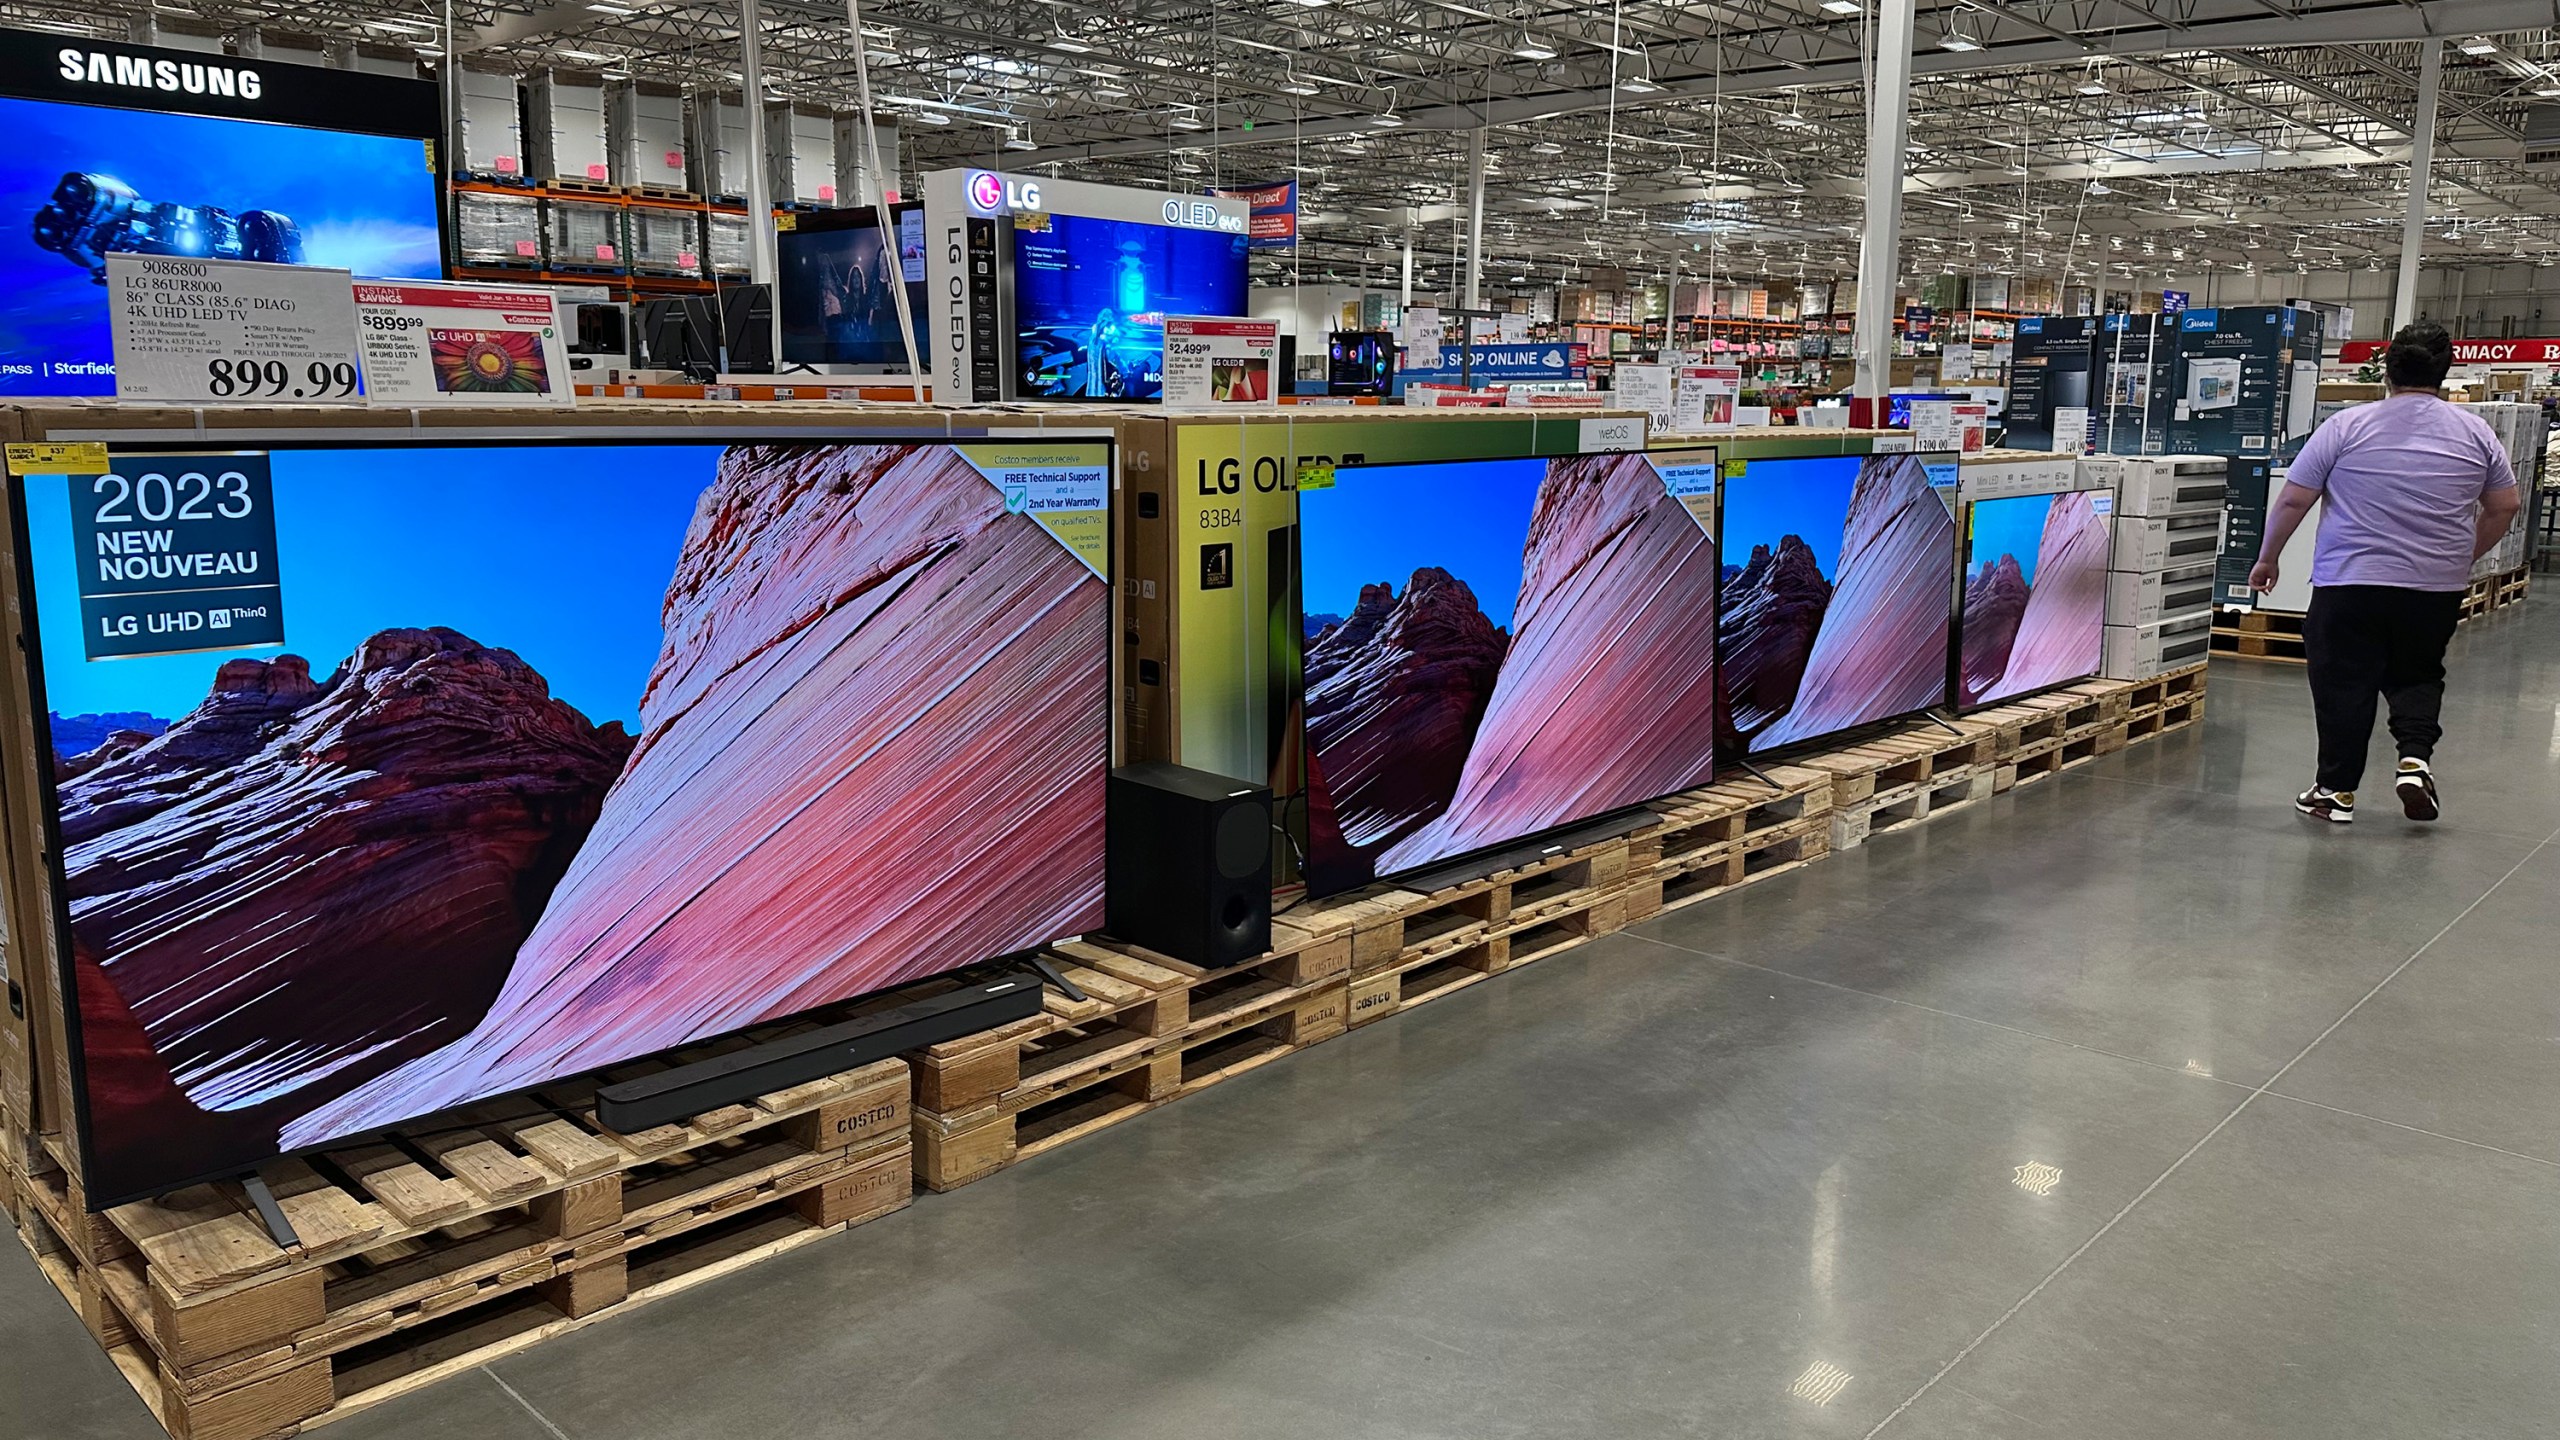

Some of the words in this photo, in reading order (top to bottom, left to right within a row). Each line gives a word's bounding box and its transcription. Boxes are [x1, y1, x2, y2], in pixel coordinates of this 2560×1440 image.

[58, 48, 261, 100] SAMSUNG
[1006, 181, 1040, 210] LG
[1253, 191, 1280, 204] Direct
[1162, 200, 1218, 228] OLED
[1219, 215, 1242, 230] evo
[948, 228, 961, 264] LG
[142, 260, 207, 277] 9086800
[126, 277, 146, 289] LG
[152, 278, 222, 293] 86UR8000
[357, 287, 400, 296] INSTANT
[126, 292, 149, 304] 86"
[155, 294, 204, 306] CLASS
[209, 295, 248, 308] (85.6"
[254, 298, 296, 312] DIAG)
[359, 294, 402, 304] SAVINGS
[127, 306, 147, 317] 4K
[152, 307, 187, 319] UHD
[193, 309, 223, 320] LED
[228, 310, 247, 321] TV
[950, 276, 964, 352] OLED
[2188, 318, 2213, 327] Midea
[430, 332, 446, 341] LG
[449, 332, 473, 342] UHD
[1419, 329, 1439, 337] 129.99
[1488, 352, 1537, 366] ONLINE
[2452, 345, 2516, 359] RMACY
[3, 365, 33, 374] PASS
[952, 356, 960, 390] evo
[209, 358, 356, 398] 899.99
[1599, 426, 1629, 439] webOS
[994, 455, 1020, 465] Costco
[1021, 455, 1054, 464] members
[1055, 455, 1080, 463] receive
[1128, 450, 1150, 472] LG
[1004, 474, 1027, 483] FREE
[1028, 472, 1067, 483] Technical
[1068, 472, 1101, 483] Support
[1199, 458, 1240, 495] LG
[1695, 468, 1711, 477] Support
[1977, 476, 1988, 485] Mini
[1989, 475, 1998, 485] LED
[94, 471, 252, 523] 2023
[1055, 486, 1068, 494] and
[1694, 485, 1711, 494] Warranty
[1028, 499, 1045, 509] 2nd
[1045, 498, 1063, 508] Year
[1064, 497, 1100, 509] Warranty
[1061, 516, 1088, 527] qualified
[1200, 508, 1241, 529] 83B4
[96, 530, 174, 555] NEW
[99, 551, 258, 581] NOUVEAU
[1124, 579, 1140, 597] ED
[2142, 578, 2156, 586] SONY
[102, 615, 138, 638] LG
[147, 612, 204, 634] UHD
[210, 610, 230, 628] AI
[232, 606, 267, 620] ThinQ
[1124, 617, 1140, 630] B4
[2140, 631, 2153, 639] SONY
[1308, 955, 1343, 974] COSTCO
[1356, 991, 1391, 1010] COSTCO
[1301, 1005, 1336, 1027] COSTCO
[837, 1104, 894, 1134] COSTCO
[840, 1170, 896, 1200] COSTCO
